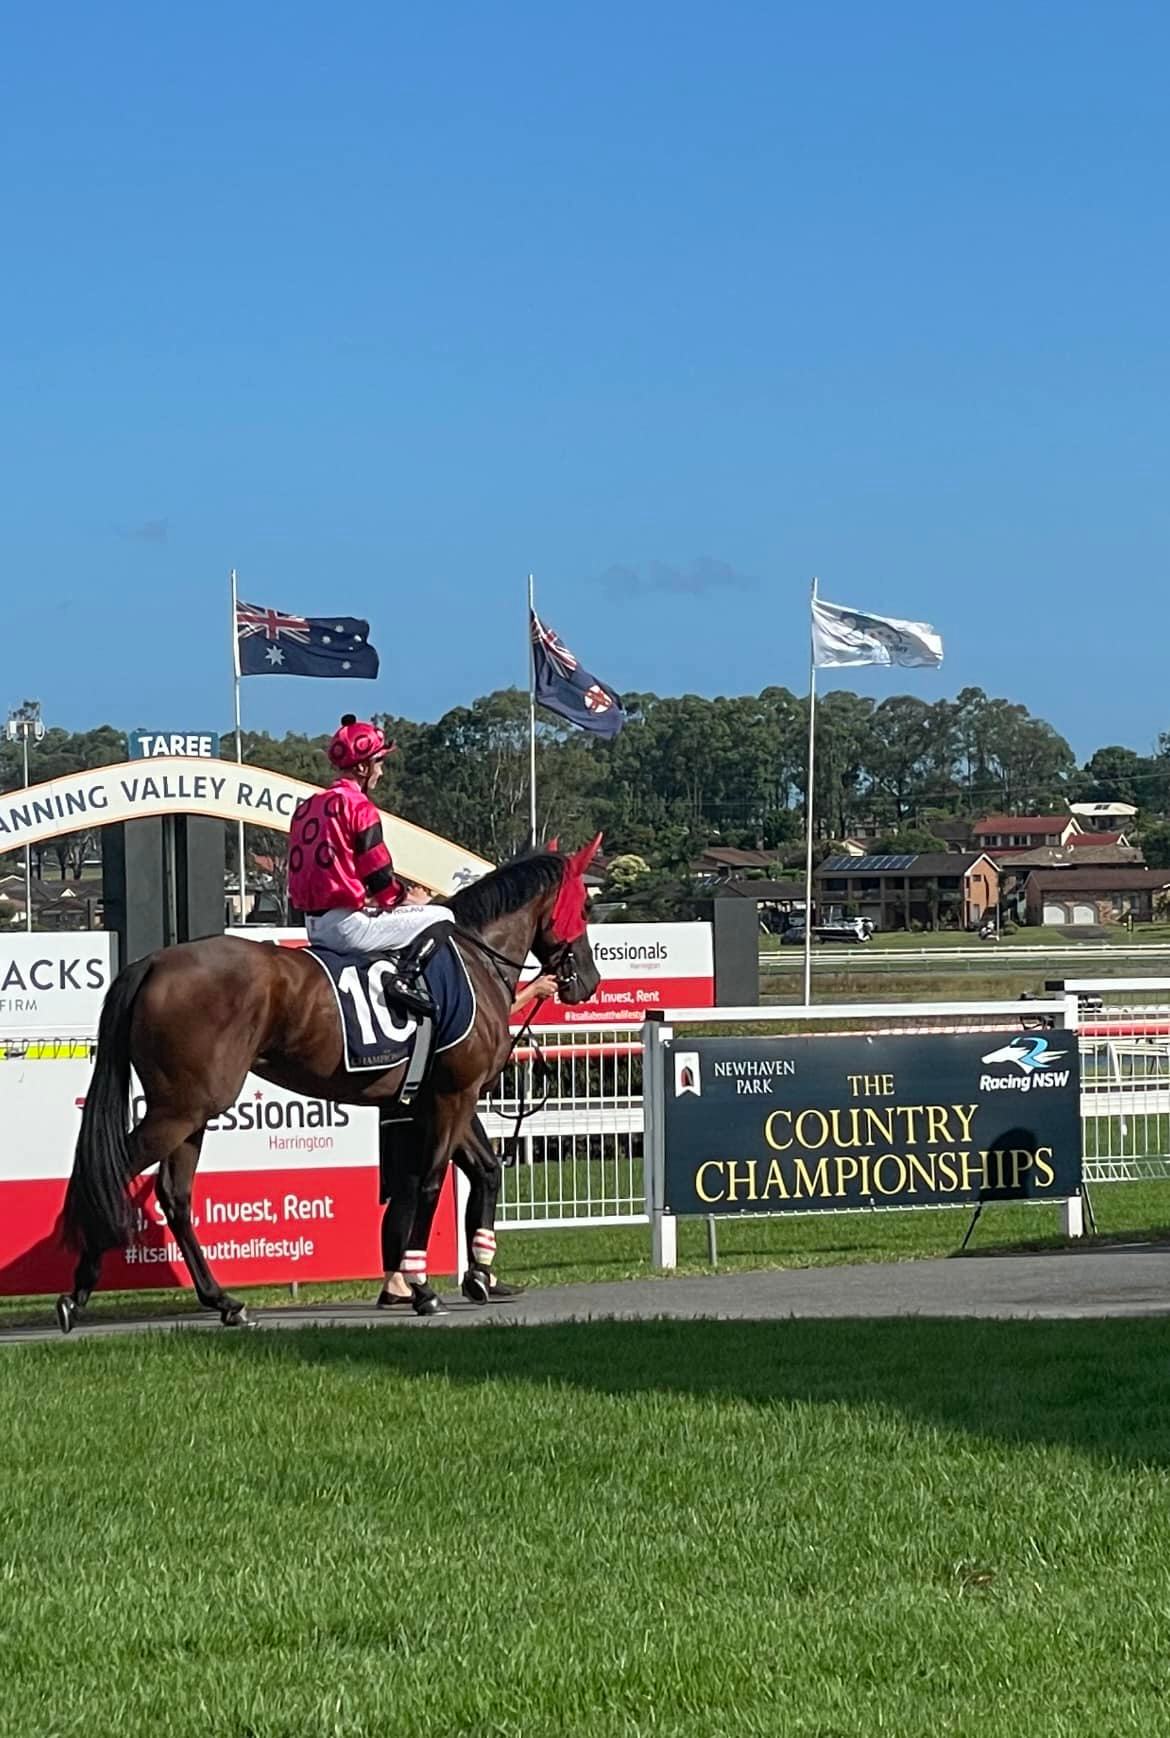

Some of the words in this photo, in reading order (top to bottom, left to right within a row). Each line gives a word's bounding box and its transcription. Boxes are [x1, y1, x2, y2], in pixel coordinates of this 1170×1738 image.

[138, 735, 212, 757] TAREE
[120, 775, 226, 802] VALLEY
[593, 941, 668, 961] fessionals
[636, 989, 660, 1003] Rent
[714, 1060, 795, 1077] NEWHAVEN
[736, 1078, 773, 1094] PARK
[847, 1074, 895, 1097] THE
[980, 1074, 1031, 1092] Racing
[1032, 1070, 1070, 1088] NSW
[764, 1104, 979, 1151] COUNTRY
[268, 1134, 334, 1152] Harrington
[695, 1147, 1055, 1203] CHAMPIONSHIPS
[205, 1197, 278, 1224] Invest,
[283, 1194, 335, 1220] Rent
